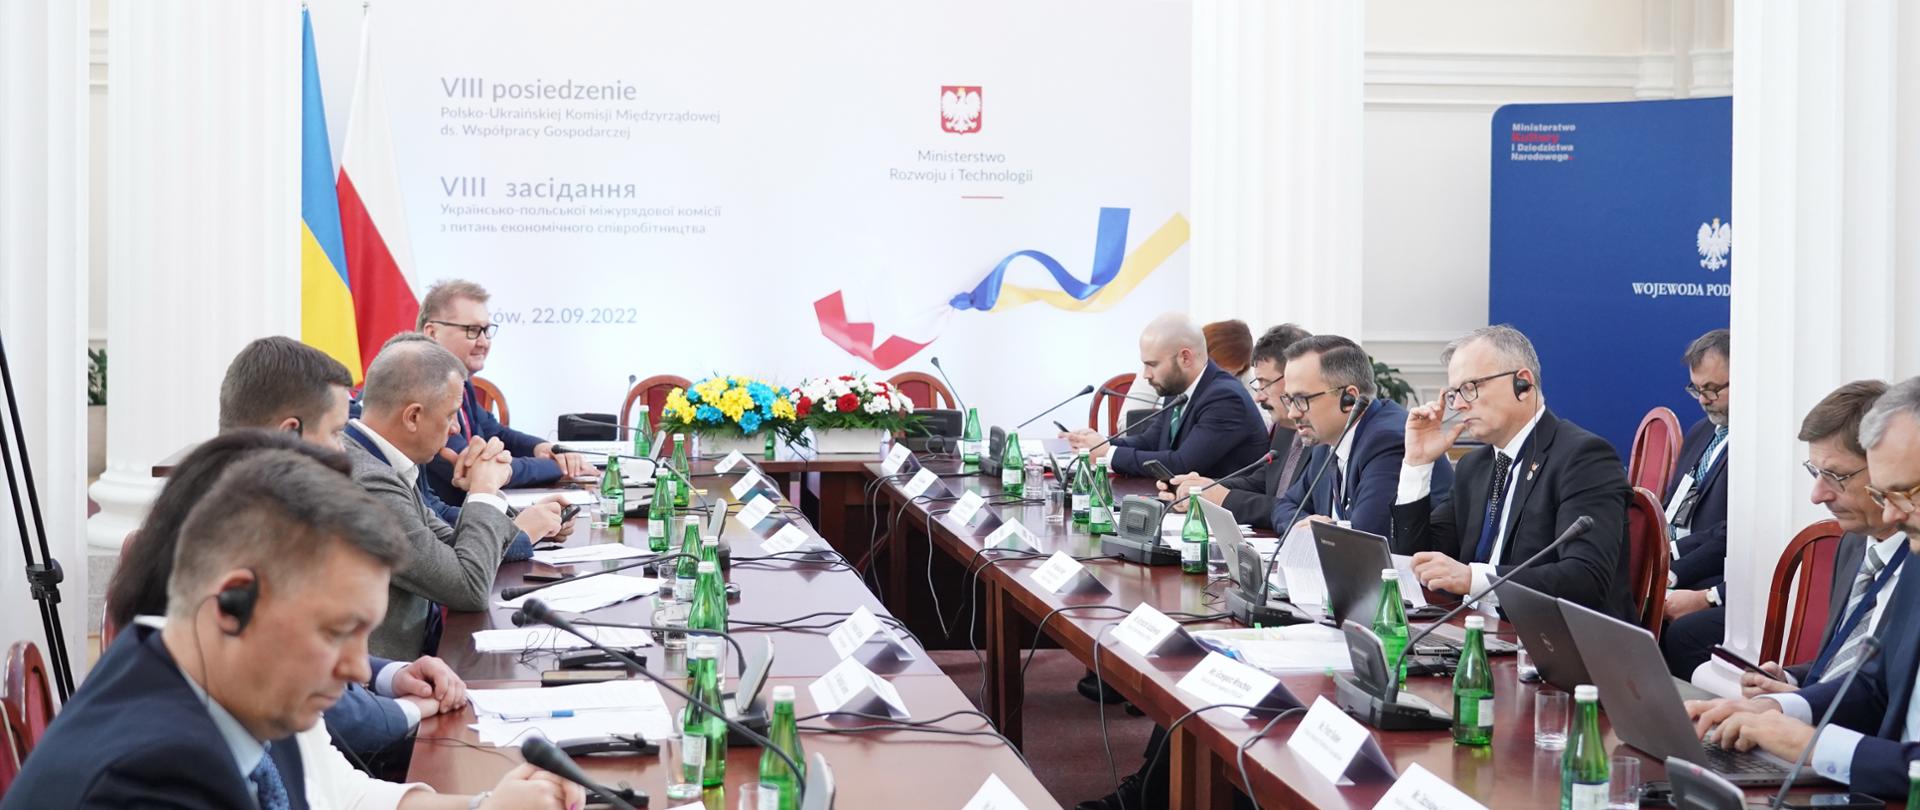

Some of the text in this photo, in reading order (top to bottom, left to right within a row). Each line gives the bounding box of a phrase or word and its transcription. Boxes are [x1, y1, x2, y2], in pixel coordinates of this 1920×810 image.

[440, 77, 637, 103] VIII posiedzenie
[440, 106, 721, 124] Polsko-Ukraińskiej Komisji Międzyrządowej
[440, 124, 631, 140] ds. Współpracy Gospodarczej
[1511, 122, 1576, 132] Ministerstwo
[1517, 143, 1574, 152] Dziedzictwa
[917, 149, 1006, 163] Ministerstwo
[889, 167, 947, 183] Rozwoju
[958, 168, 1033, 184] Technologii
[440, 176, 636, 202] VIII засідання
[440, 203, 722, 218] Українсько-польської міжурядової комісії
[440, 221, 706, 236] з питань економічного співробітництва
[1632, 282, 1704, 298] WOJEWODA
[531, 307, 638, 324] 22.09.2022
